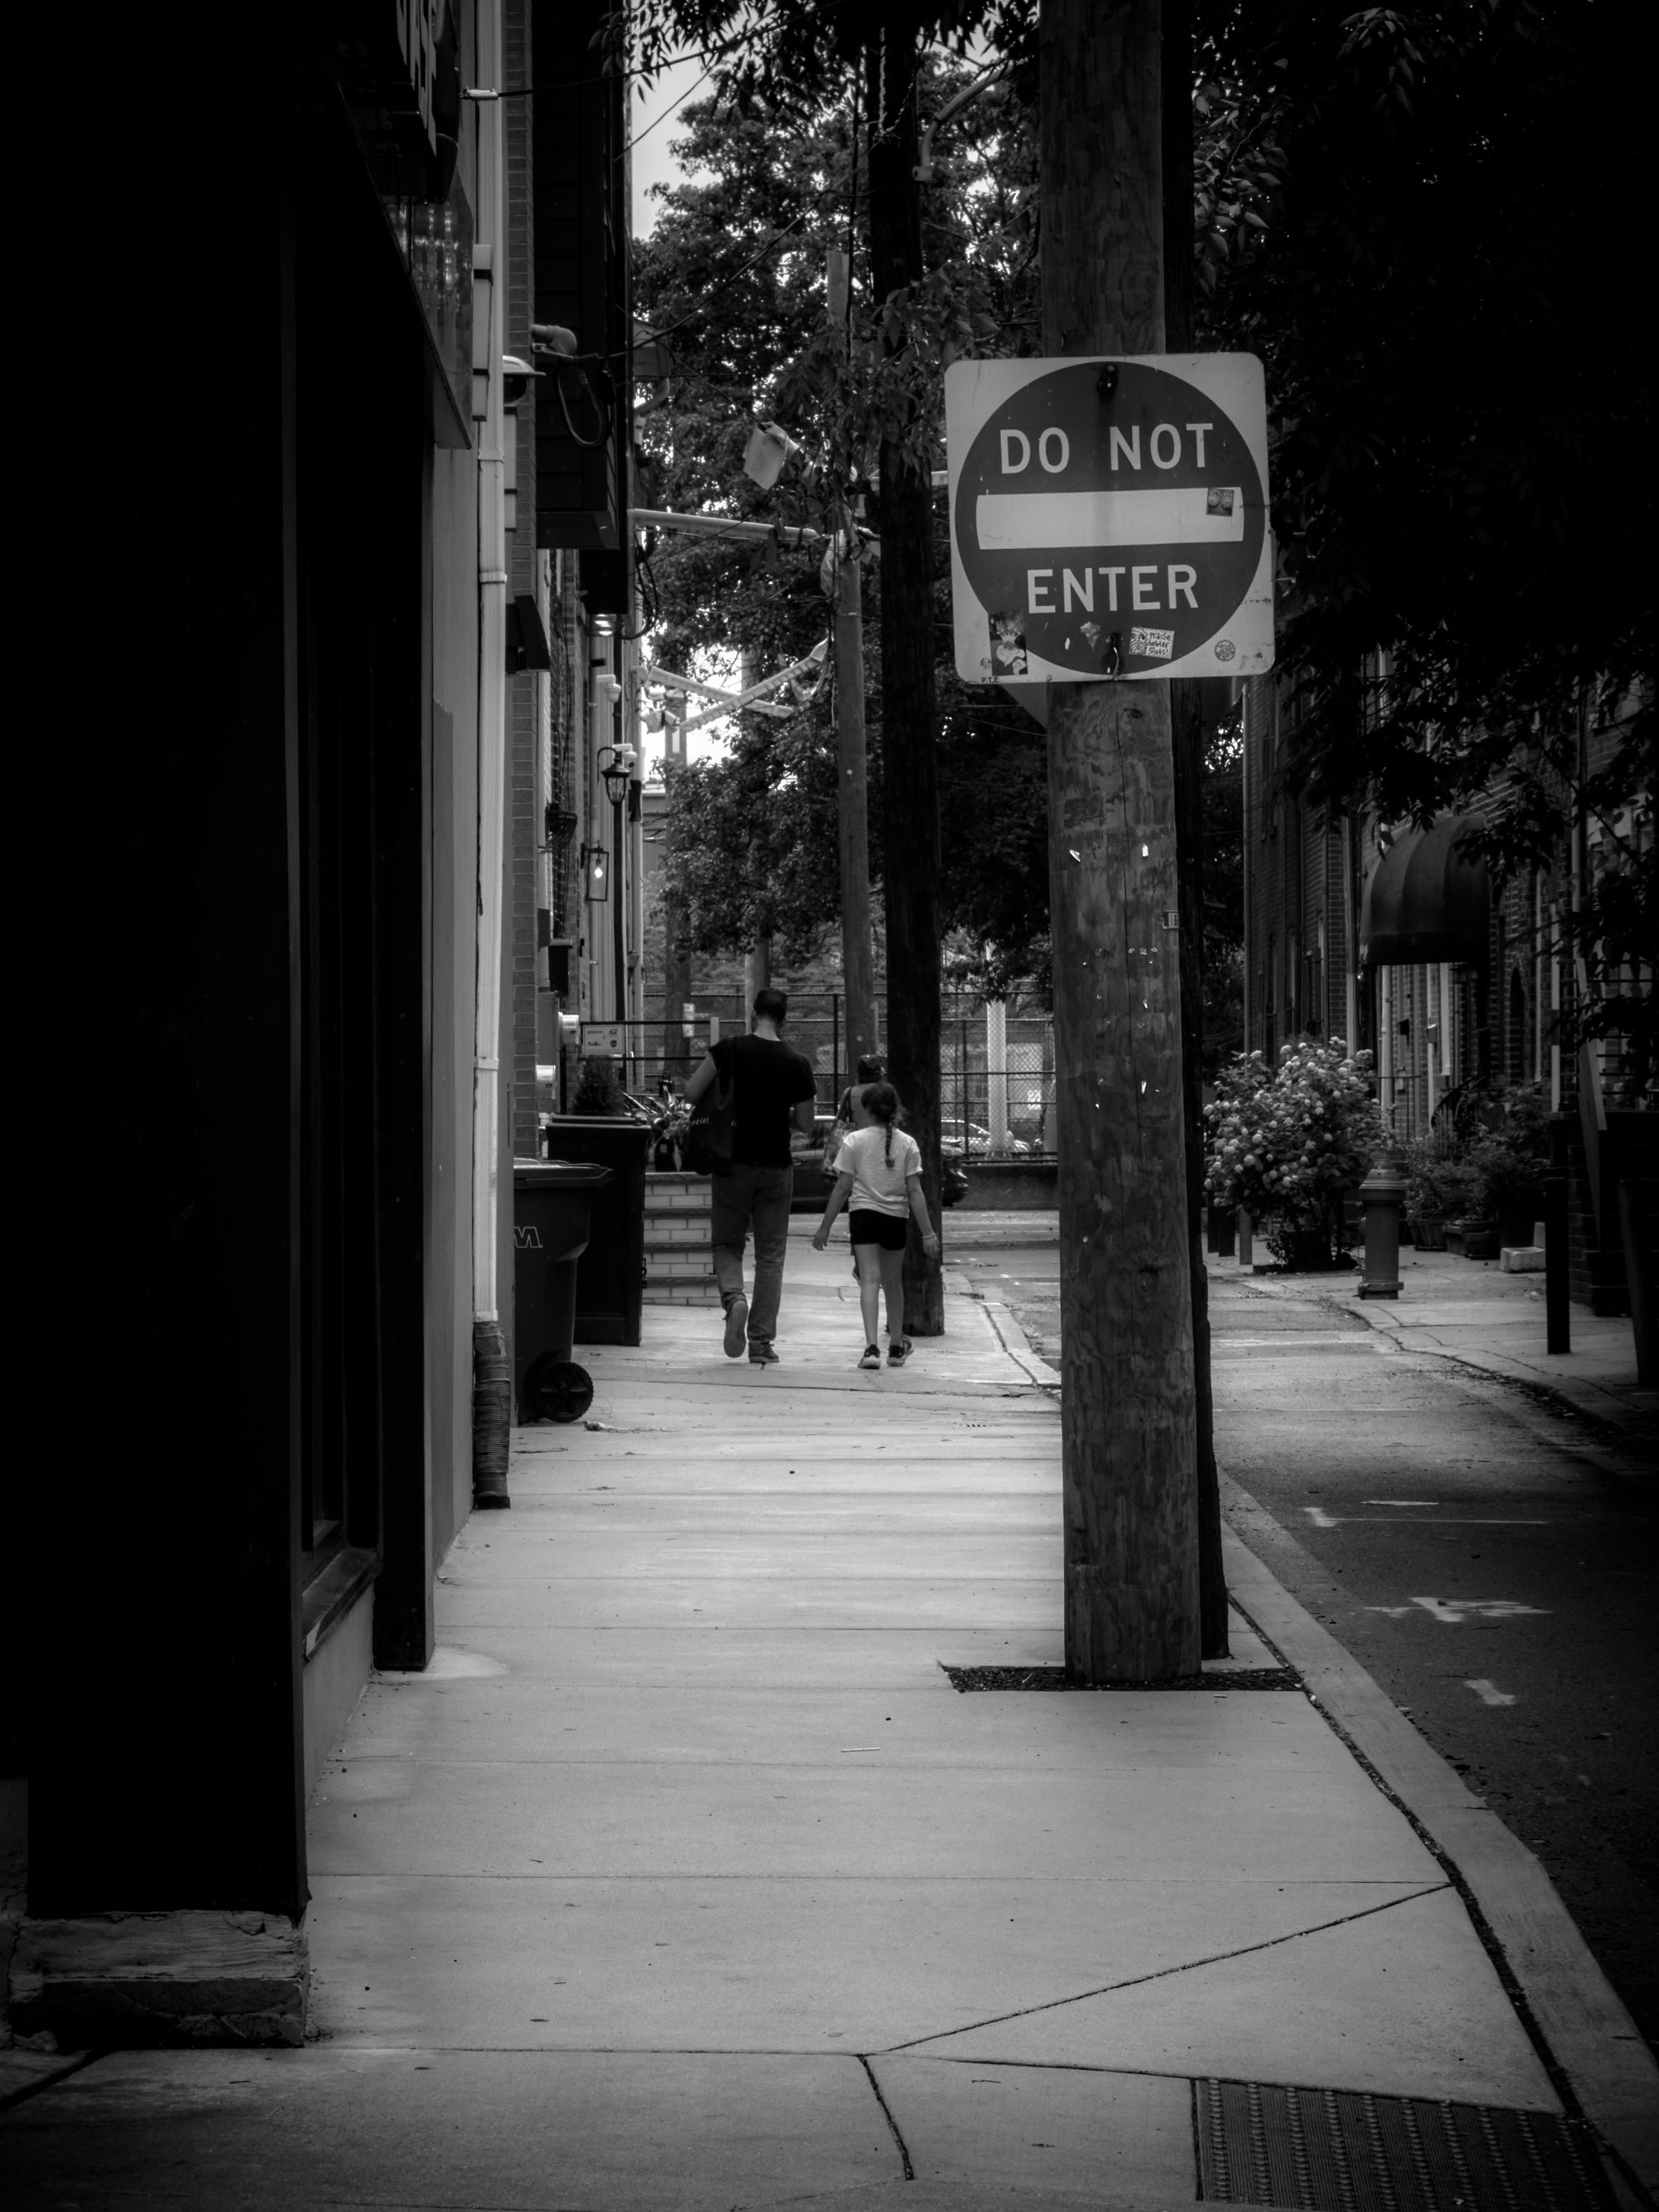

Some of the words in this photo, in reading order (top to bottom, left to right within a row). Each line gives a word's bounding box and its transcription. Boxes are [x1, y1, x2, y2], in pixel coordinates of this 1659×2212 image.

[1000, 427, 1070, 474] DO
[1109, 423, 1214, 471] NOT
[1027, 564, 1199, 614] ENTER
